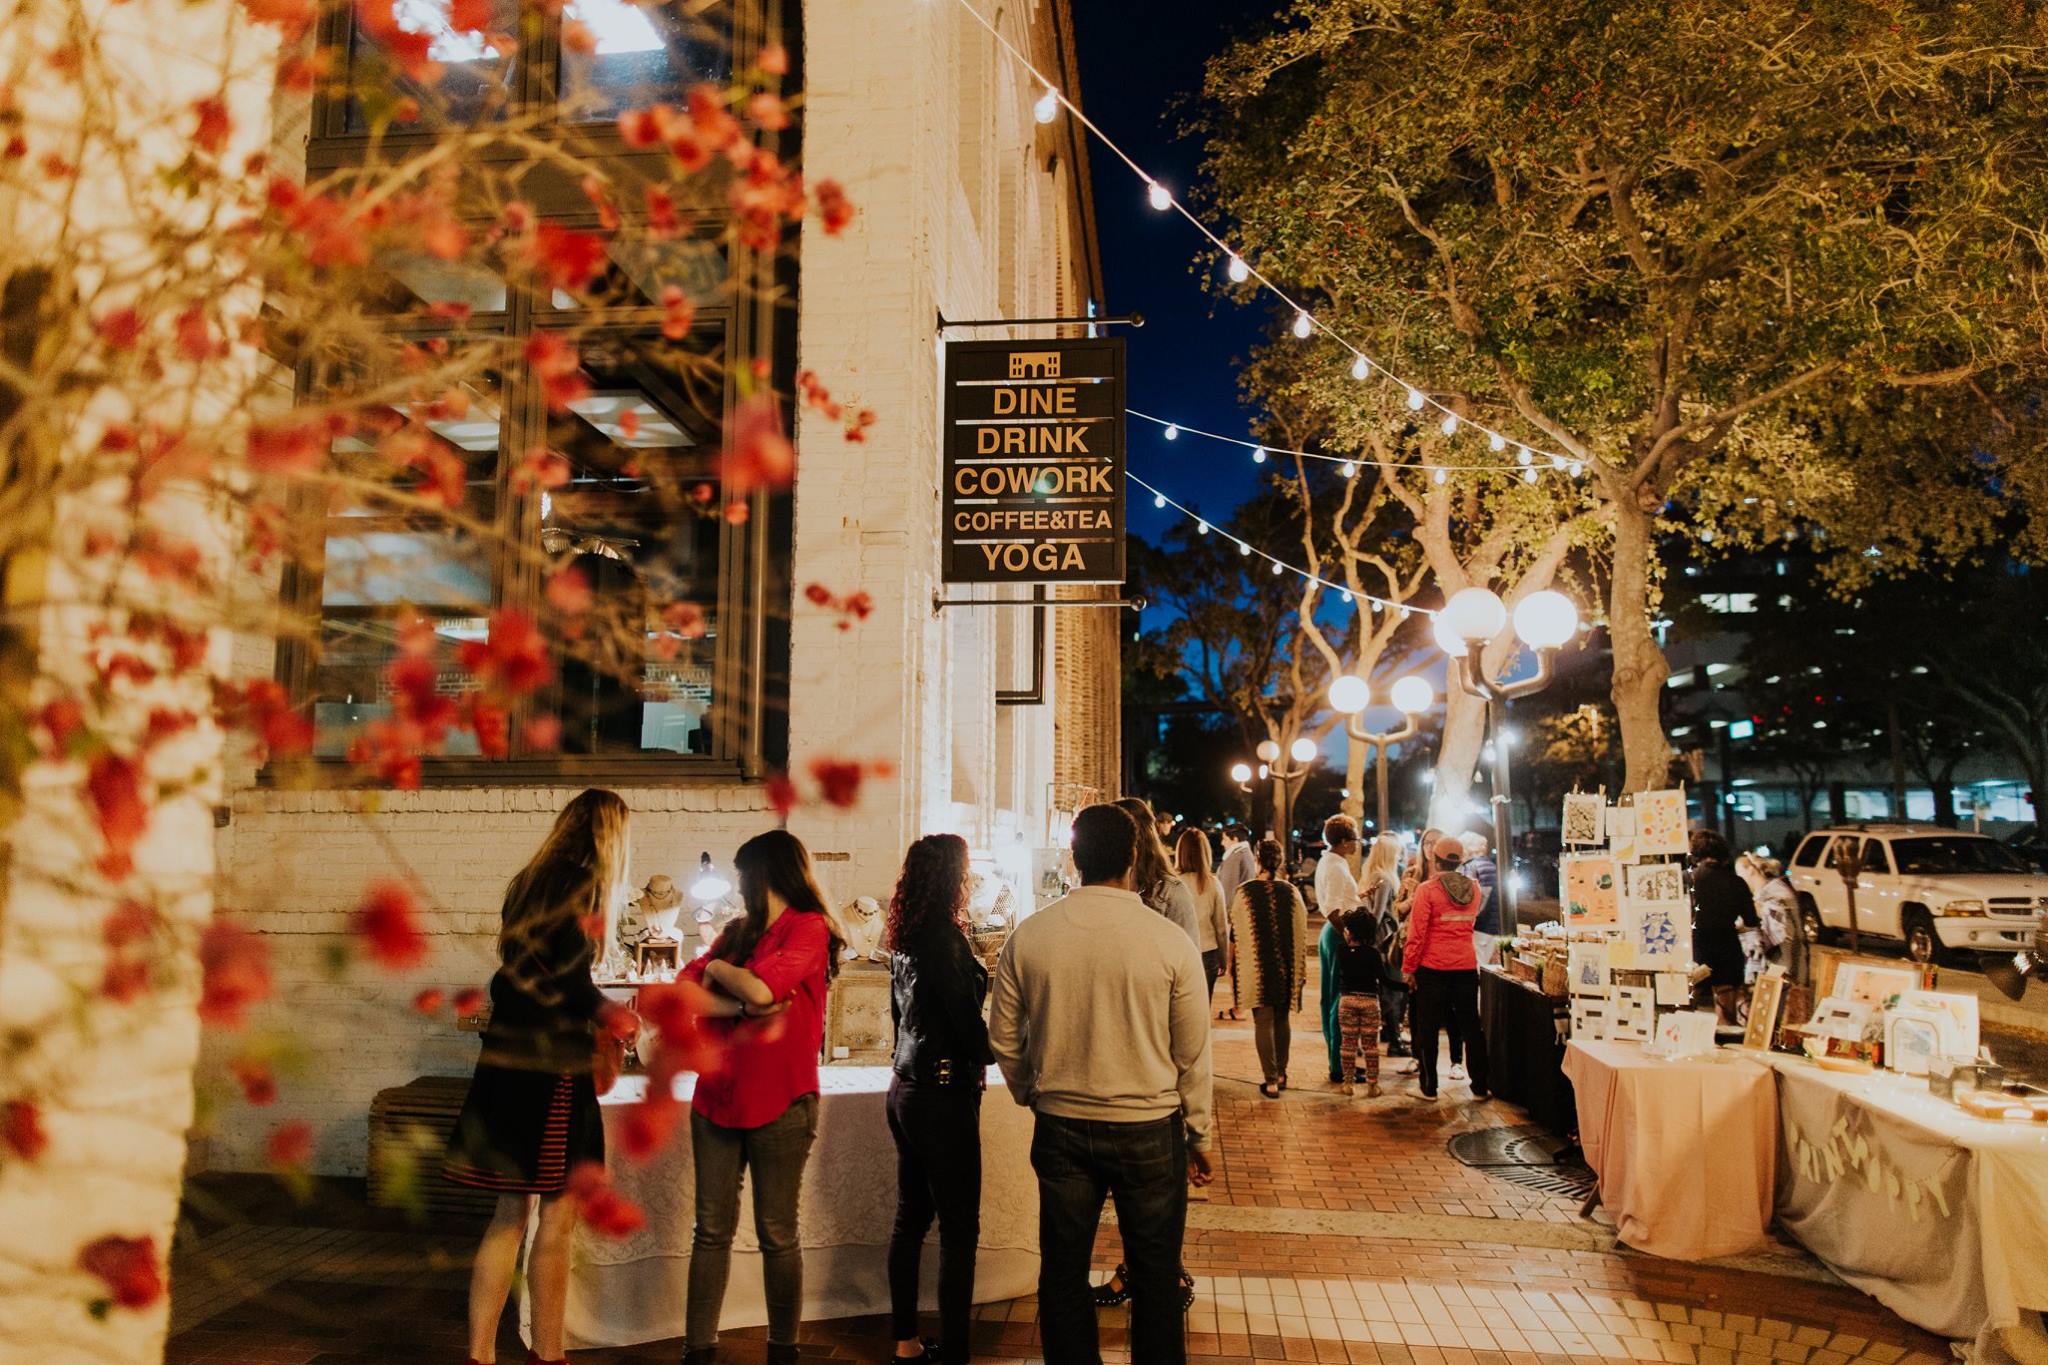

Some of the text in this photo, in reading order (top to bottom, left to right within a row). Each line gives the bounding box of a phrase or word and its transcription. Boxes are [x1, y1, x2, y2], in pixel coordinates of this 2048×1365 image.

[993, 387, 1077, 414] DINE
[977, 426, 1090, 454] DRINK
[954, 466, 1114, 495] COWORK
[954, 510, 1113, 532] COFFEE&TEA
[980, 543, 1086, 572] YOGA
